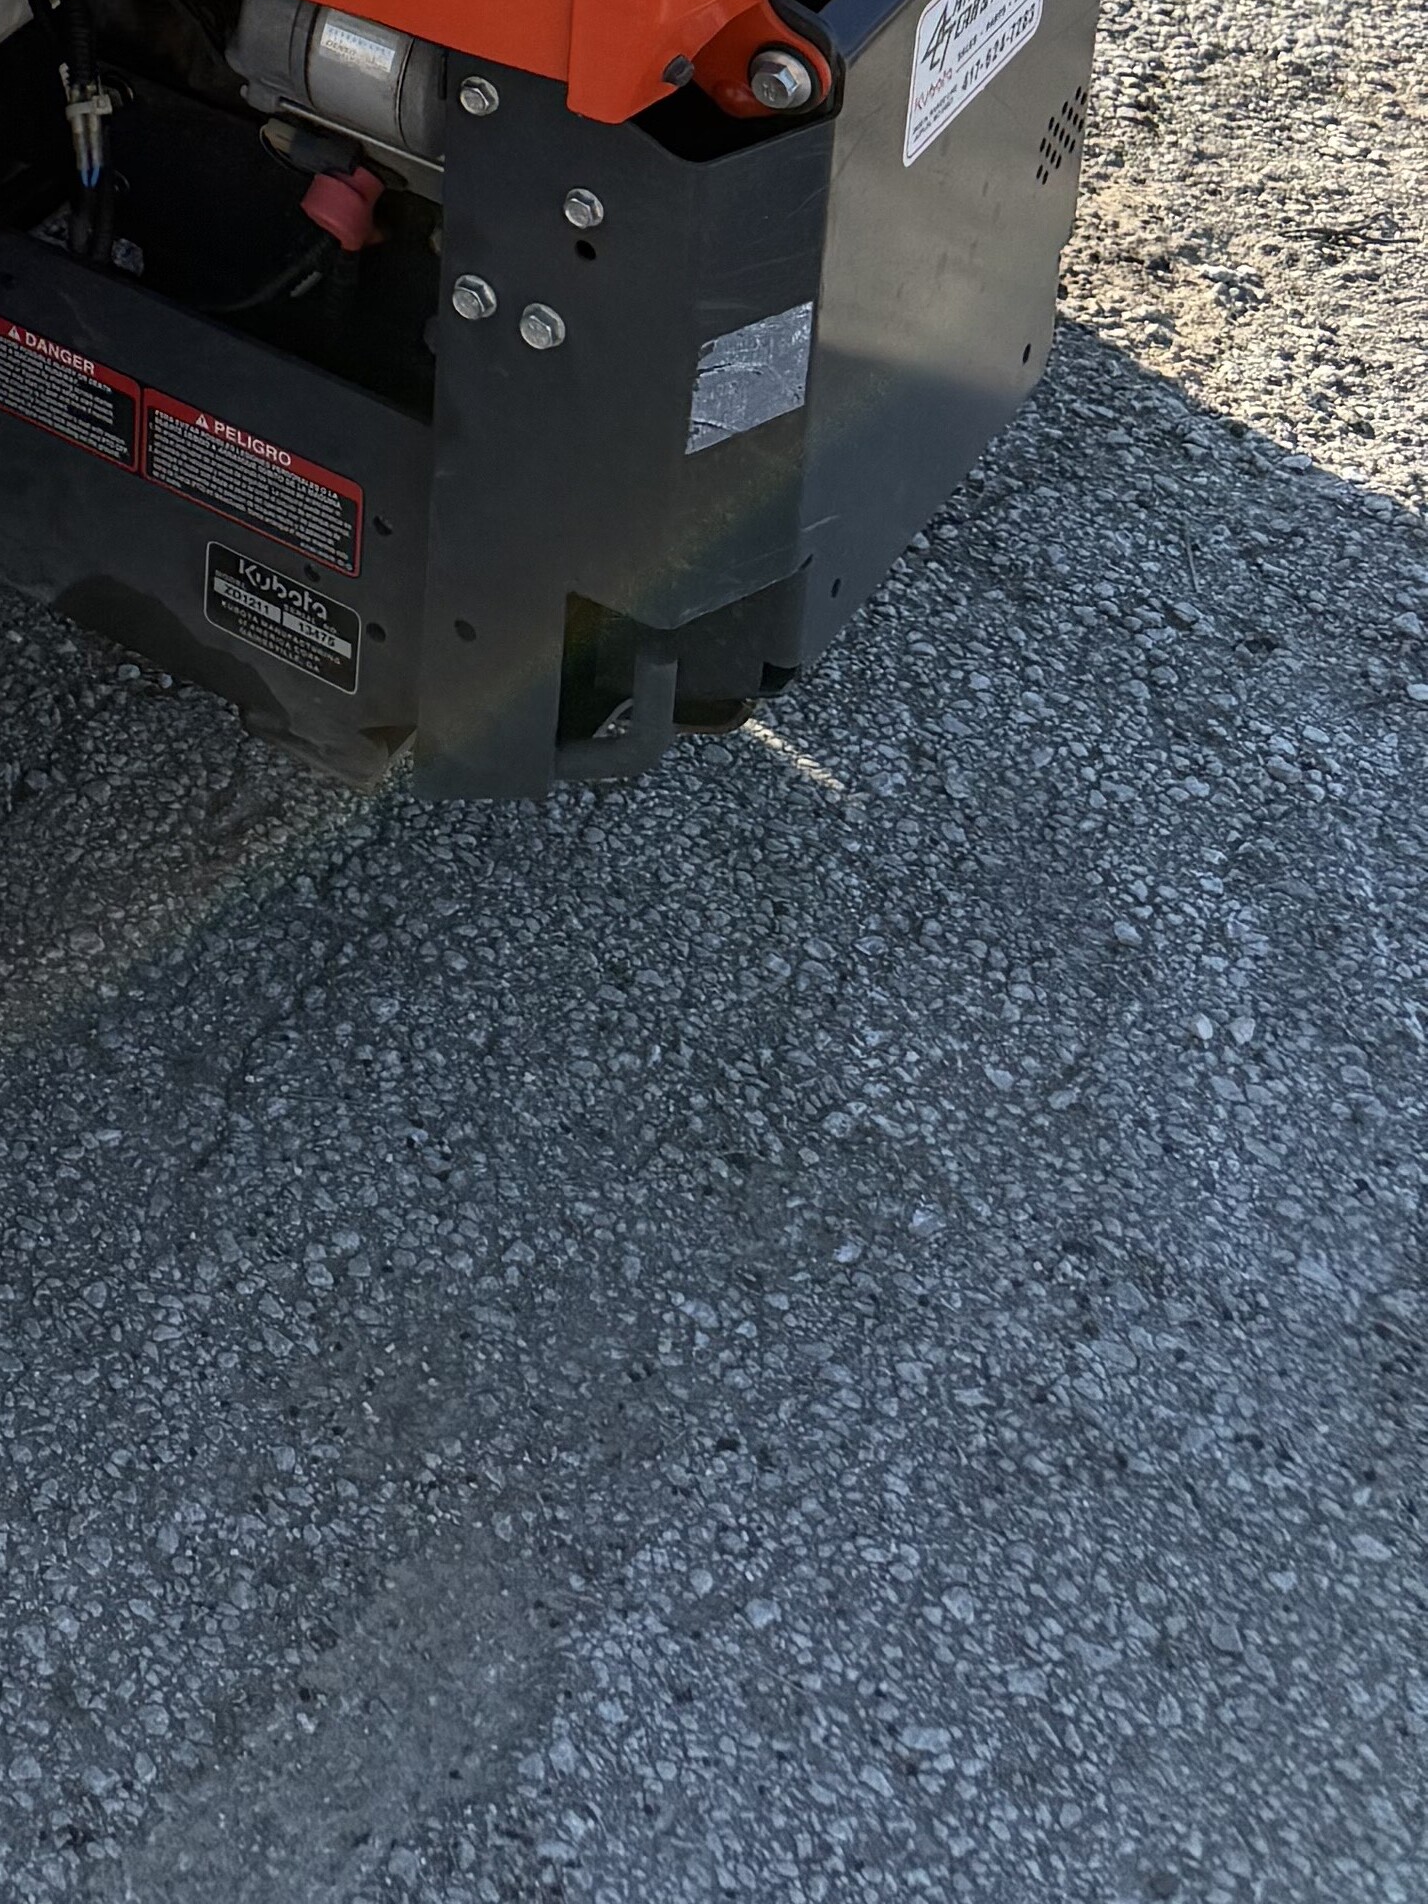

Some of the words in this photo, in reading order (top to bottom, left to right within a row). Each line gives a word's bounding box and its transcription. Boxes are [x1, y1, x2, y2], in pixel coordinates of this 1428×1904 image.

[25, 331, 95, 376] DANGER
[214, 420, 291, 467] PELIGRO
[224, 583, 269, 615] ZD1211
[237, 557, 328, 621] Kubota
